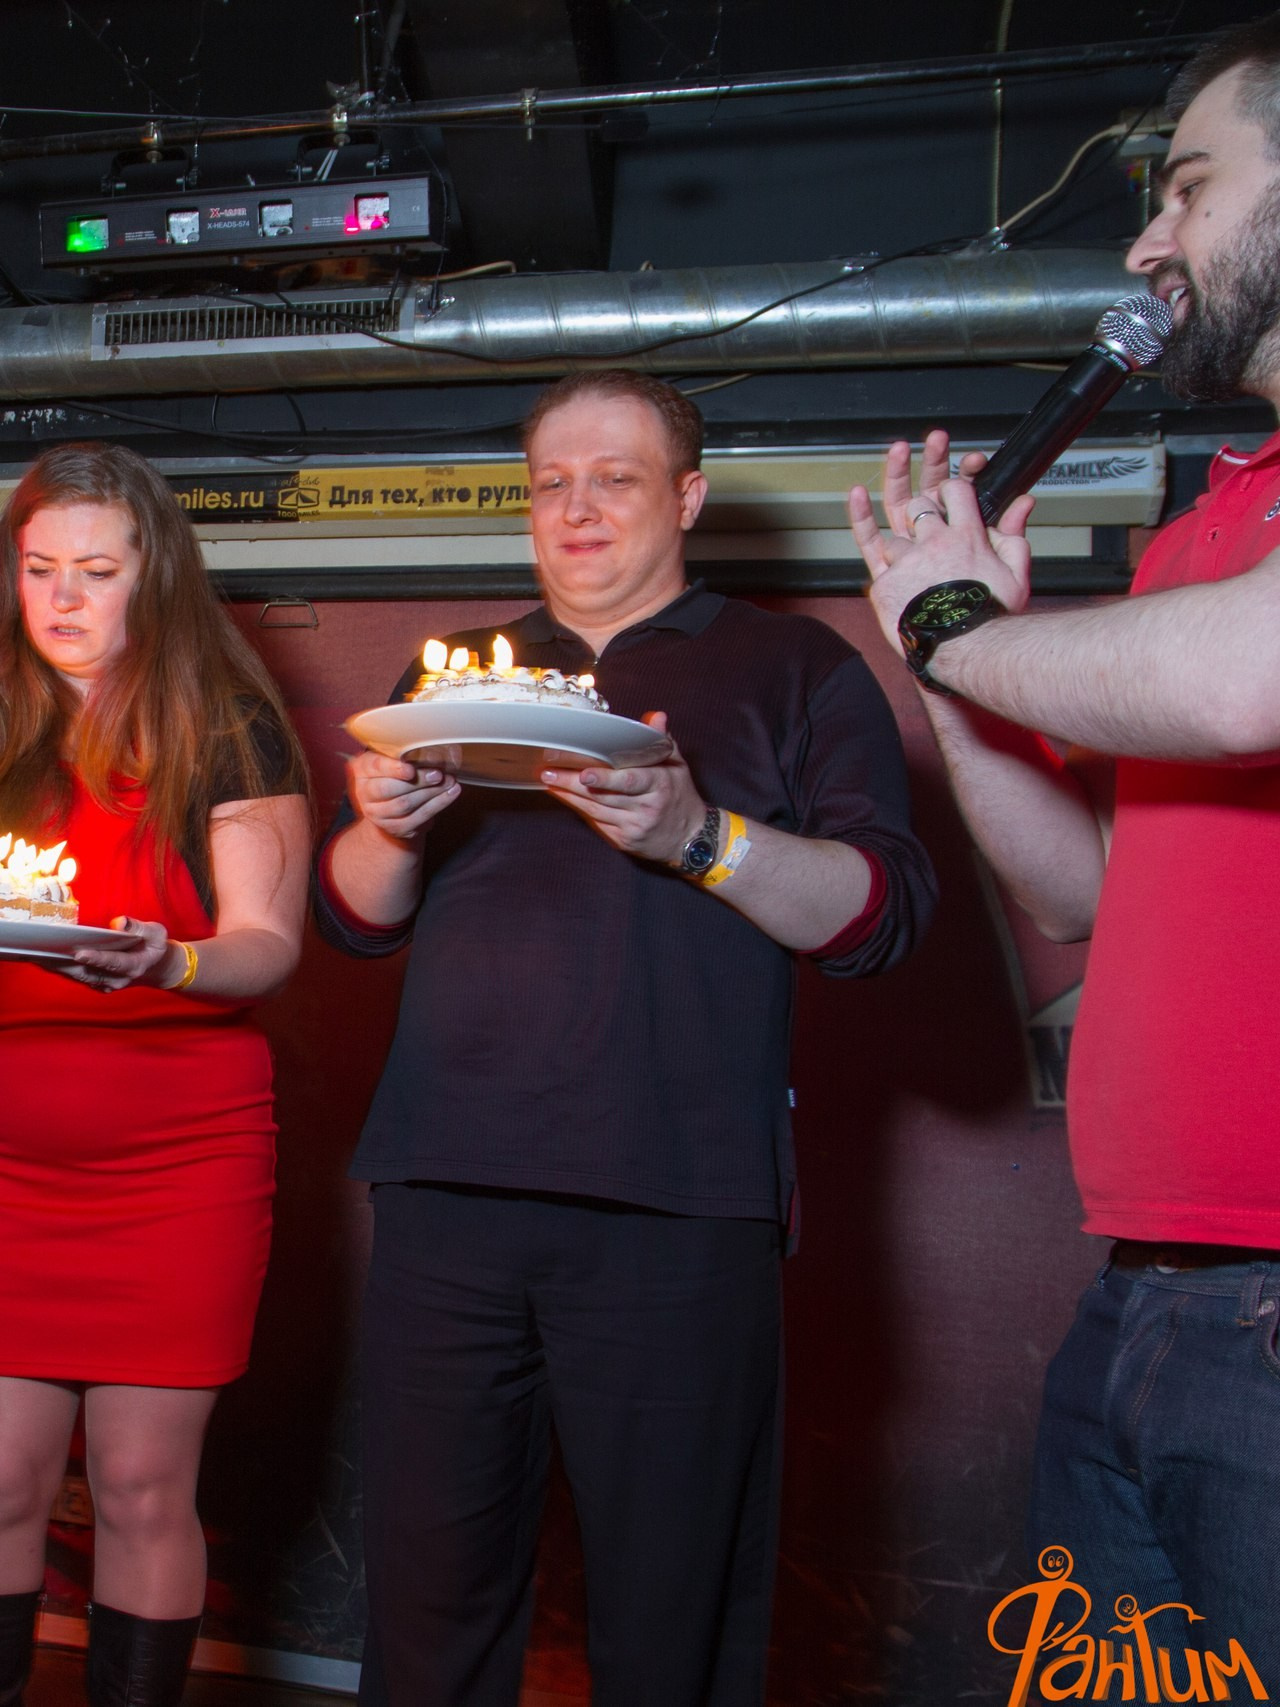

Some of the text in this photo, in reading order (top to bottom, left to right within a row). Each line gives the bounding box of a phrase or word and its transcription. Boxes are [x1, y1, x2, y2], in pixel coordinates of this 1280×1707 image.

[207, 220, 250, 230] X-HEADS-574
[1037, 479, 1090, 487] PRODUCTION
[329, 485, 373, 508] Для
[381, 487, 425, 507] тех,
[432, 486, 471, 503] кто
[278, 510, 297, 518] 1000
